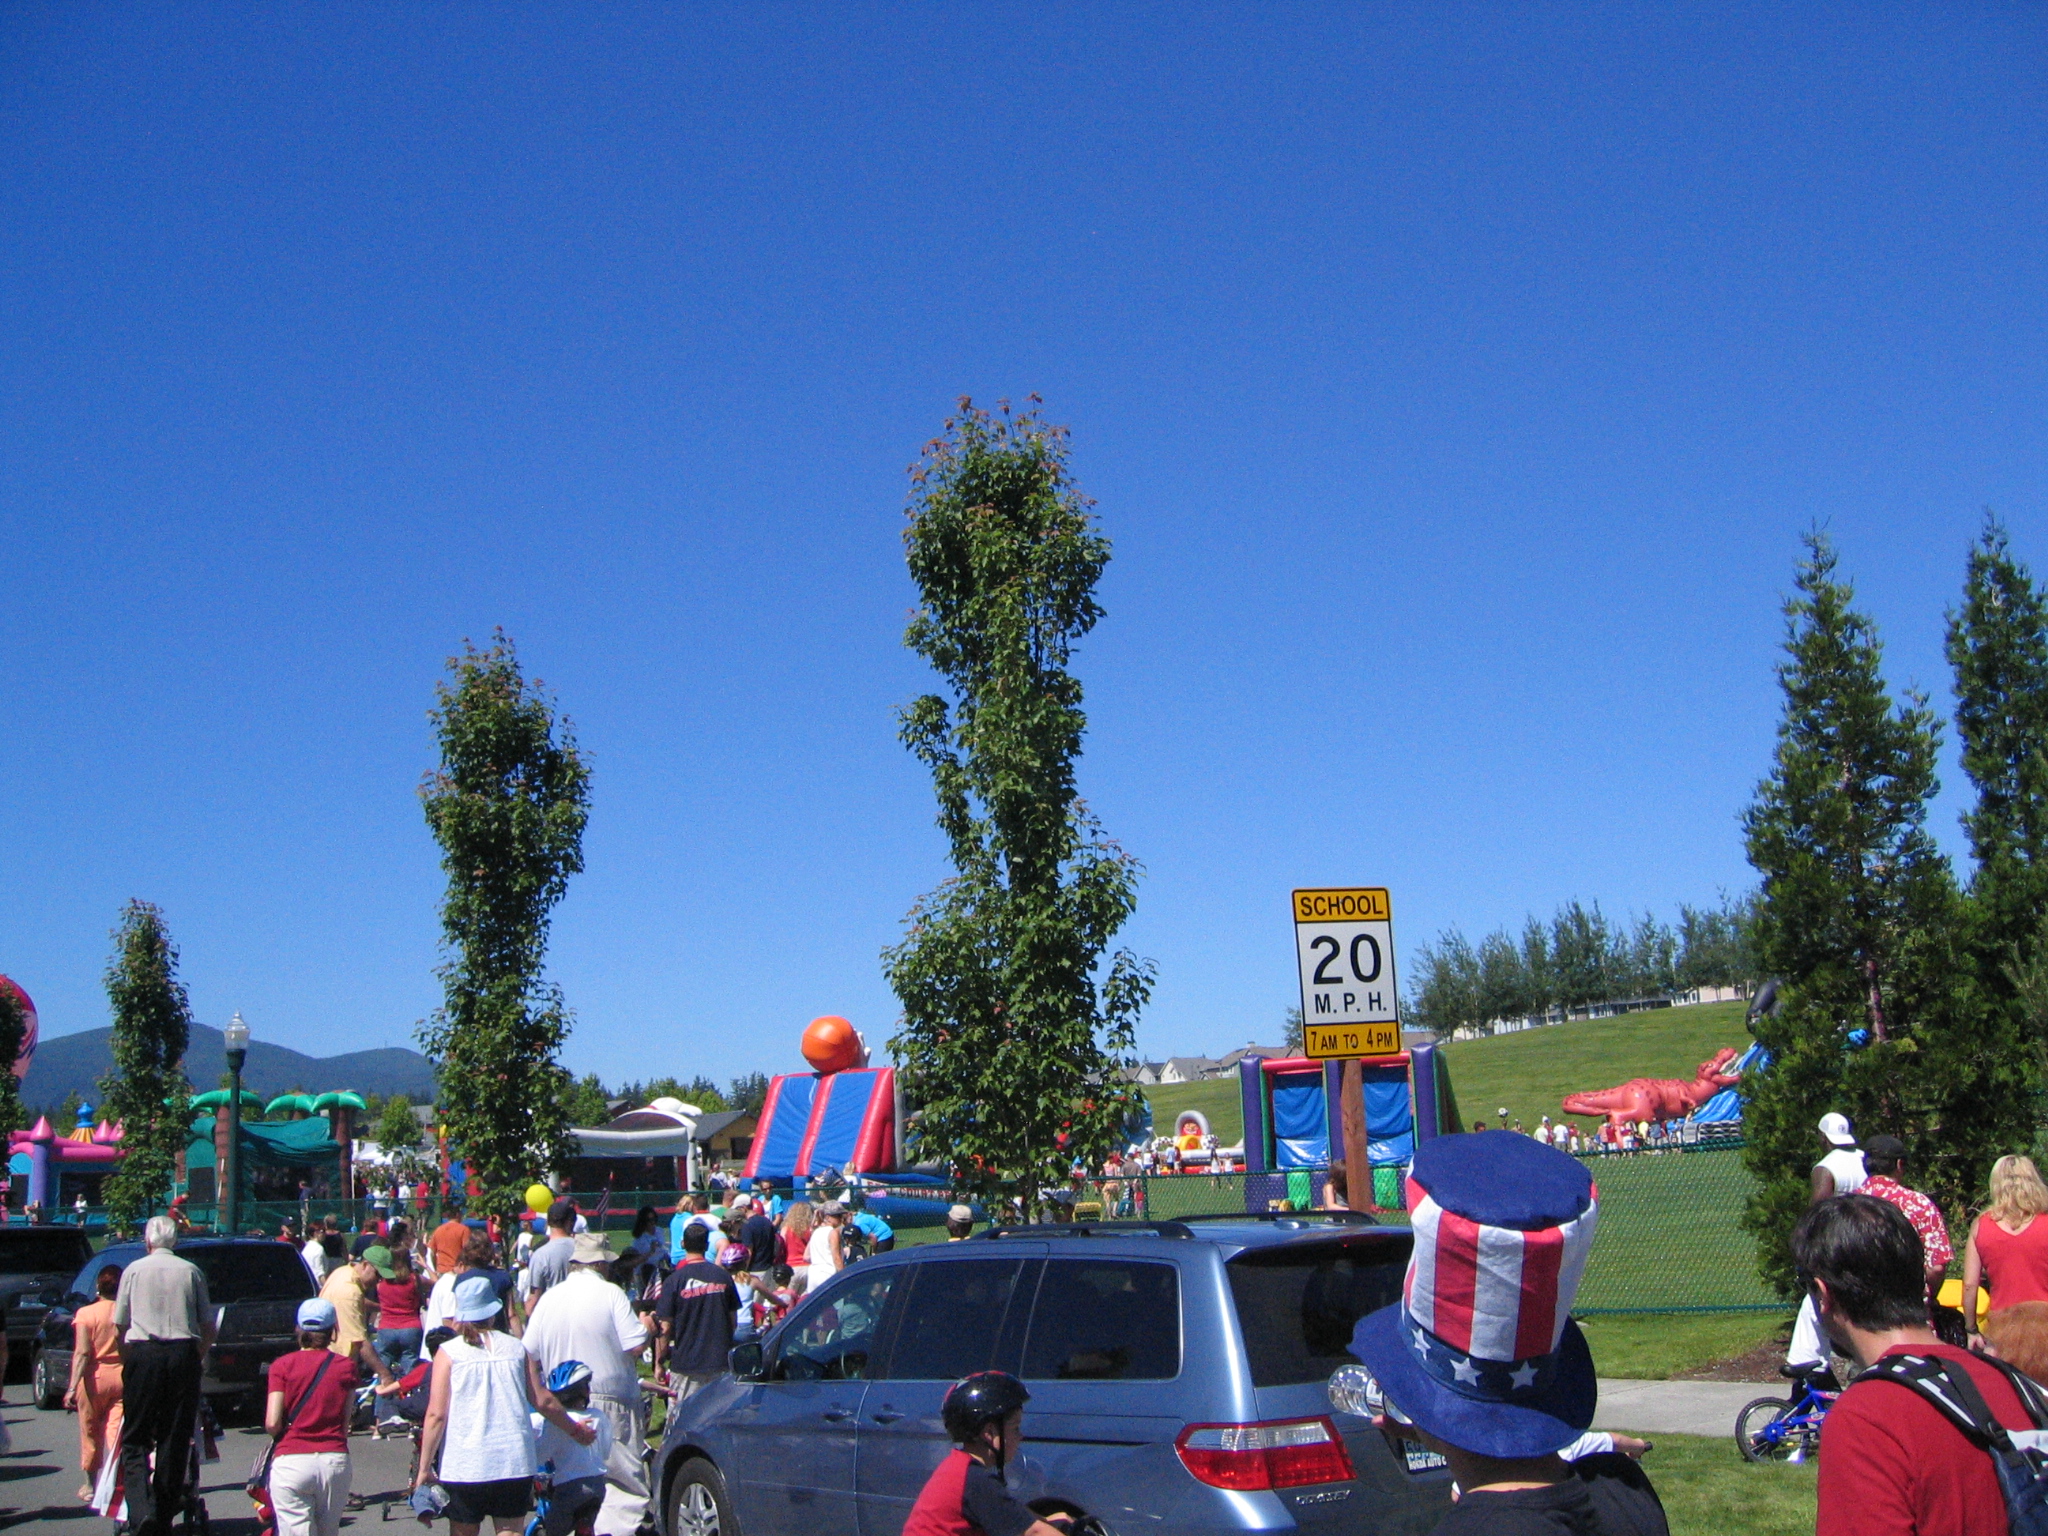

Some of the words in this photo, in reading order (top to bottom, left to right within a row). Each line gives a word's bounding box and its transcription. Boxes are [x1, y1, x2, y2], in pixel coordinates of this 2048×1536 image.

[1300, 895, 1384, 917] SCHOOL
[1310, 933, 1382, 985] 20
[1310, 1031, 1318, 1051] 7
[1320, 1034, 1338, 1051] AM
[1343, 1033, 1359, 1050] TO
[1366, 1028, 1373, 1048] 4
[1377, 1031, 1393, 1047] PM
